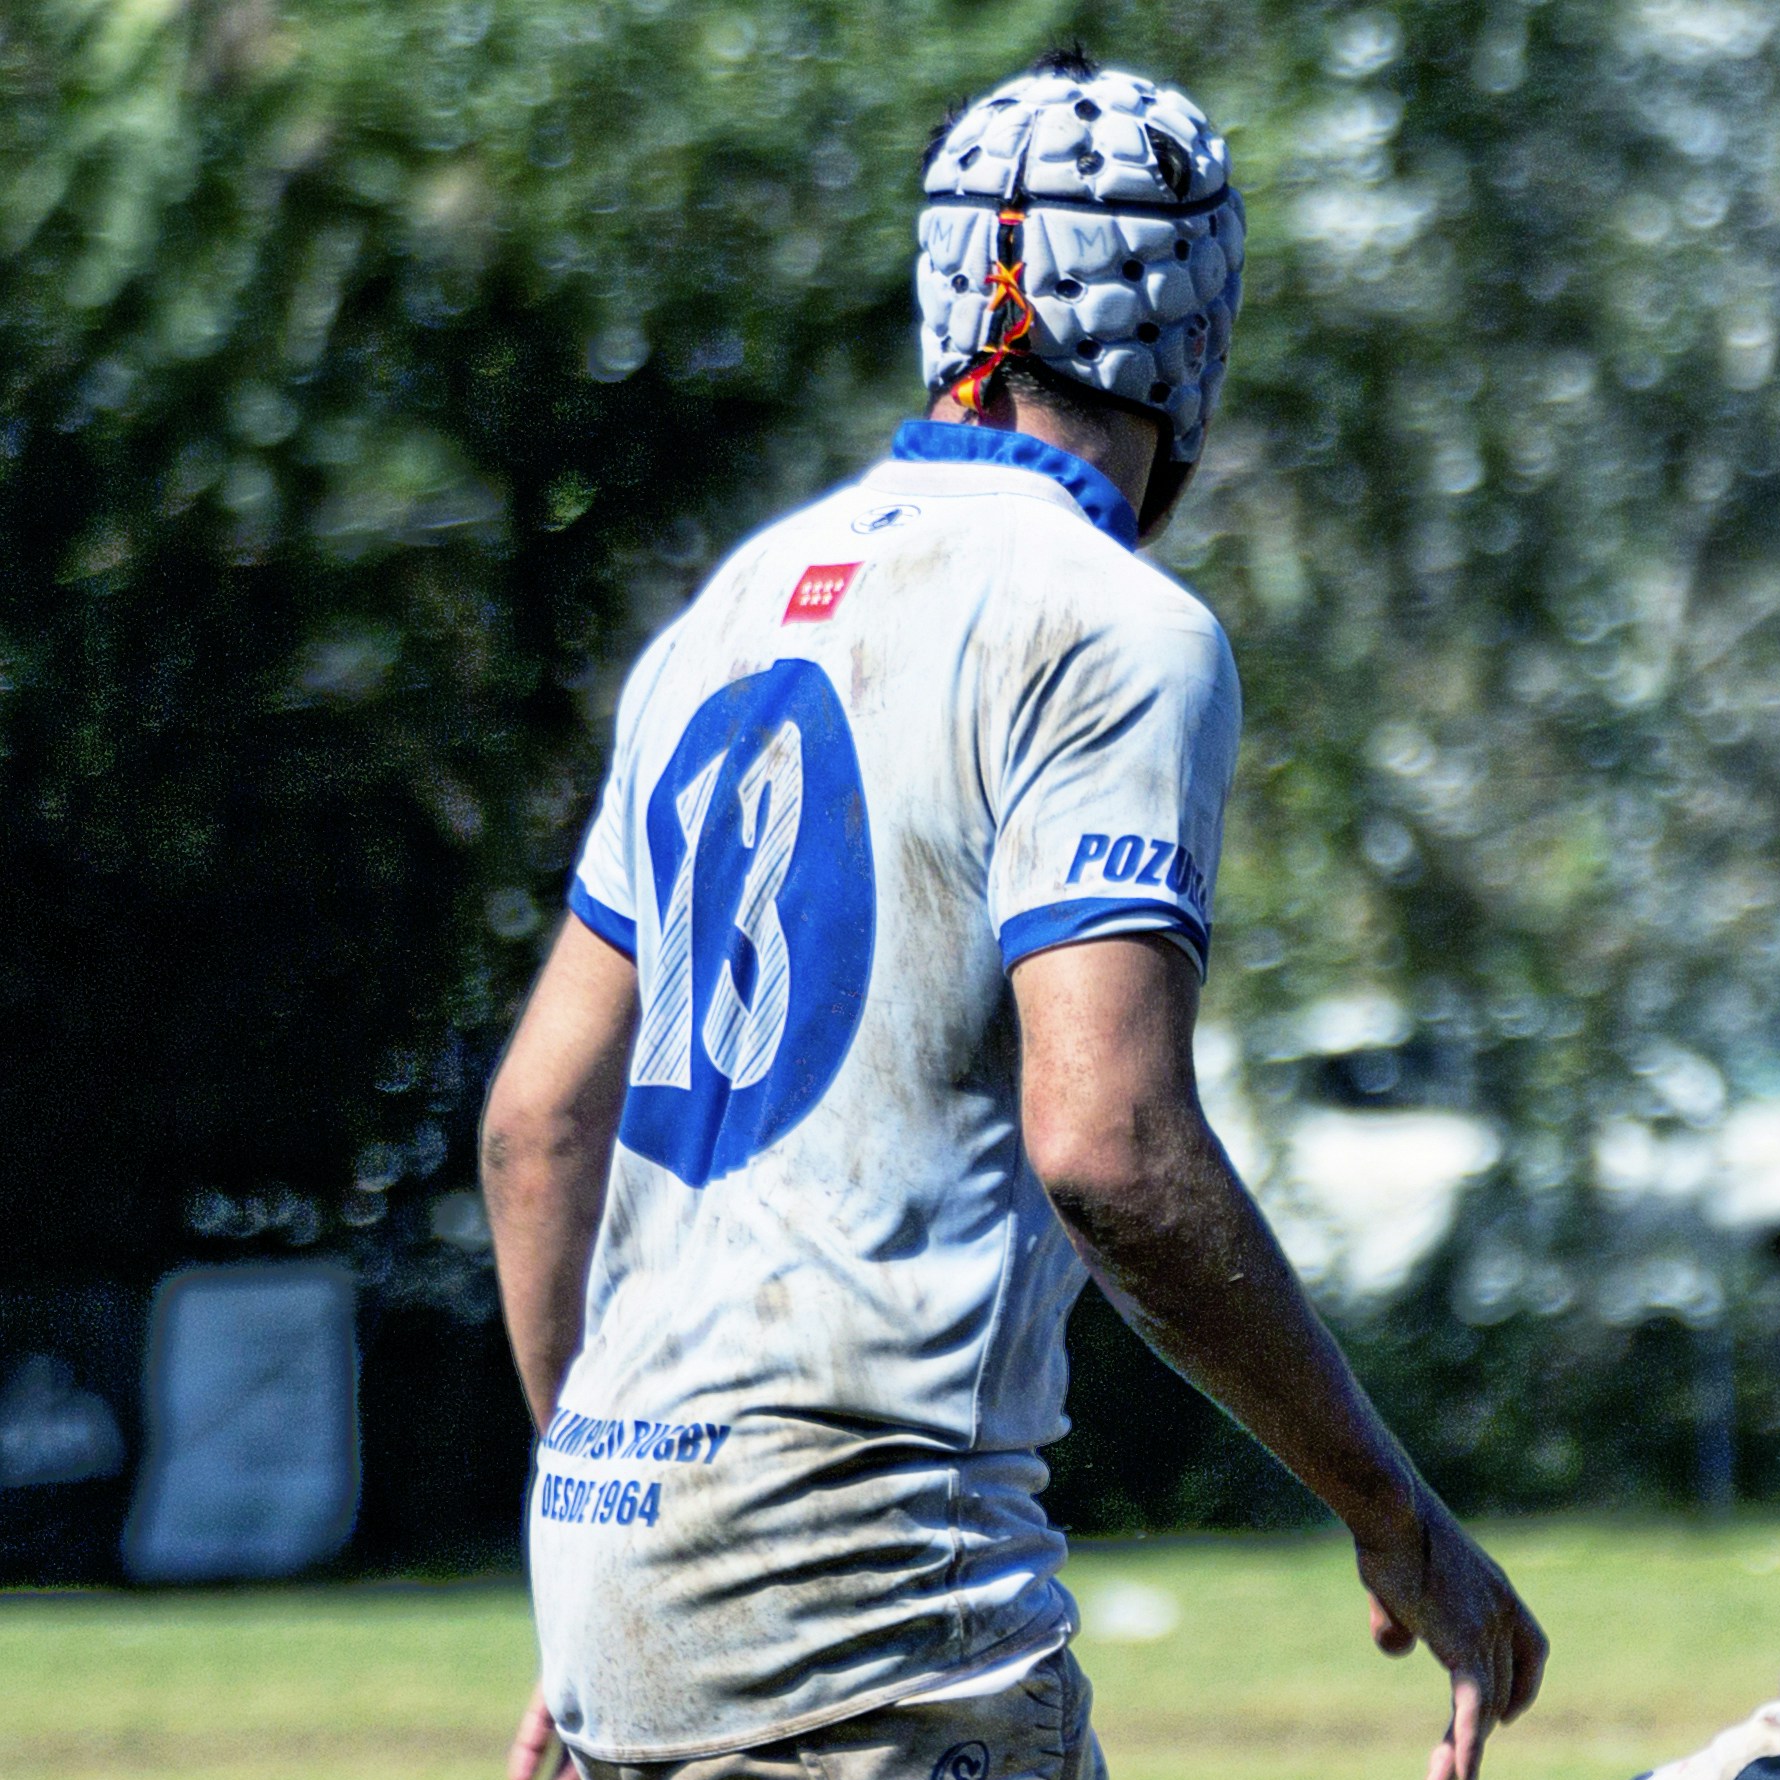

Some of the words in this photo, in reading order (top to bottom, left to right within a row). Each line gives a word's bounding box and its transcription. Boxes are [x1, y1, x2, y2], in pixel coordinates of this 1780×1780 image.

[629, 720, 803, 1091] 13
[621, 1420, 732, 1465] RUGBY
[591, 1479, 662, 1528] 1964
